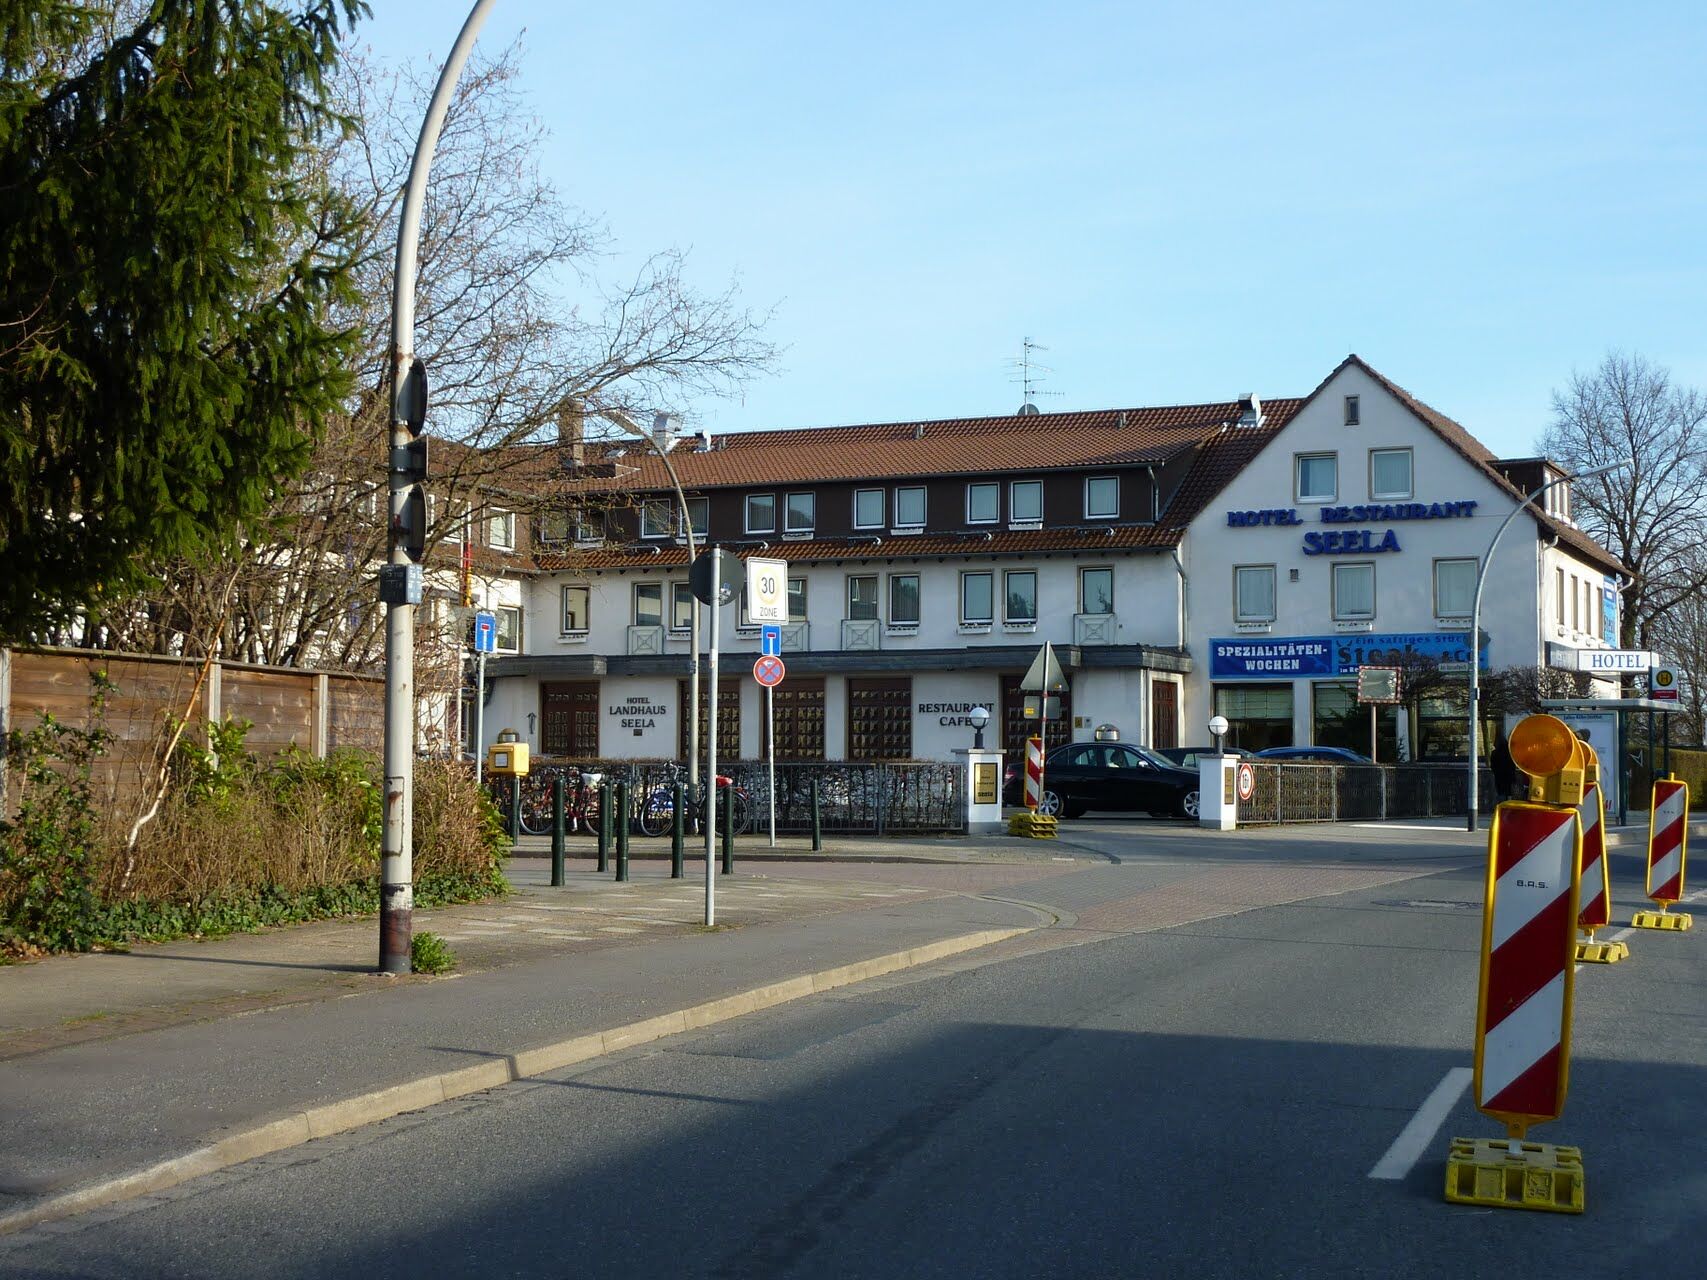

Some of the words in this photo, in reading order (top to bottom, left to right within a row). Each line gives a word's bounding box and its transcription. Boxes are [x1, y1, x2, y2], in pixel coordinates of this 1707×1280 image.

[1227, 509, 1303, 527] HOTEL
[1320, 501, 1477, 523] RESTAURANT
[1303, 529, 1401, 555] SEELA
[761, 577, 775, 594] 30
[760, 606, 778, 617] ZONE
[1217, 643, 1328, 657] SPEZIALITÄTEN-
[1245, 659, 1300, 670] WOCHEN
[1592, 654, 1644, 668] HOTEL
[610, 705, 667, 715] LANDHAUS
[621, 718, 656, 728] SEELA
[1516, 879, 1549, 889] B.A.S.
